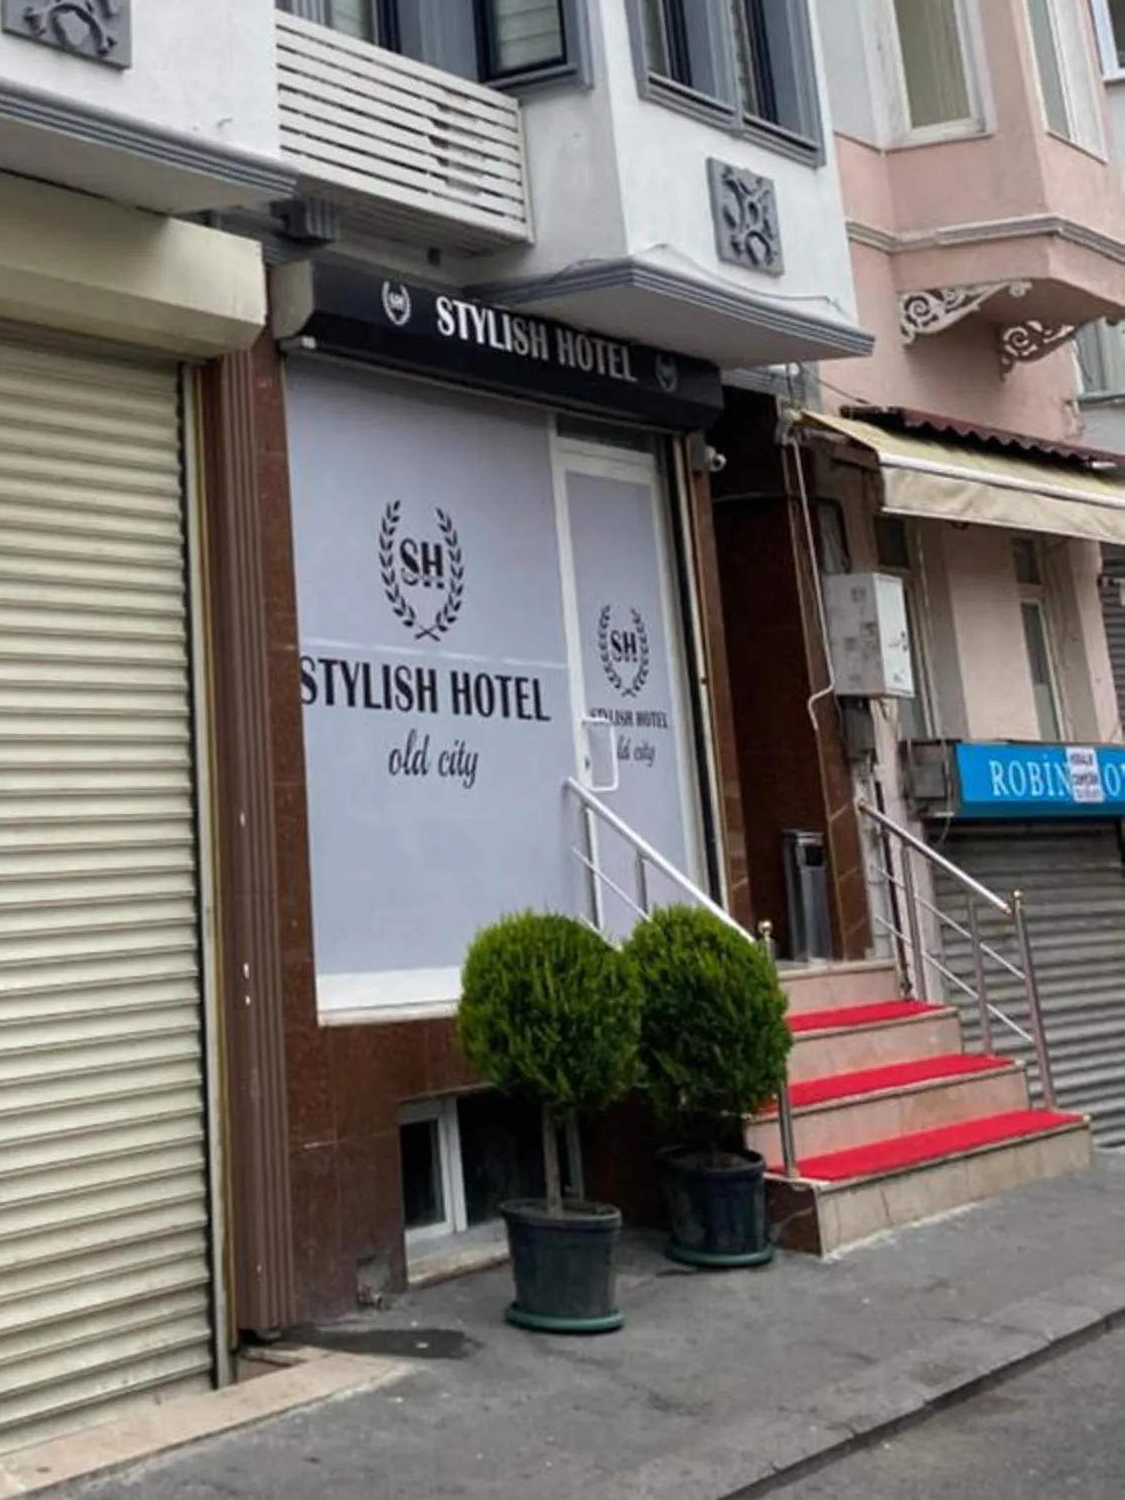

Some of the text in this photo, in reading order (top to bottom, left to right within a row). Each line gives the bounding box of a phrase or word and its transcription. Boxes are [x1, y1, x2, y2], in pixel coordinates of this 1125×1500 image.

[436, 296, 638, 383] STYLISH HOTEL
[400, 538, 444, 589] SH
[610, 630, 638, 663] SH
[299, 656, 551, 722] STYLISH HOTEL
[635, 710, 668, 728] HOTEL
[389, 729, 479, 789] old city
[633, 740, 656, 767] city
